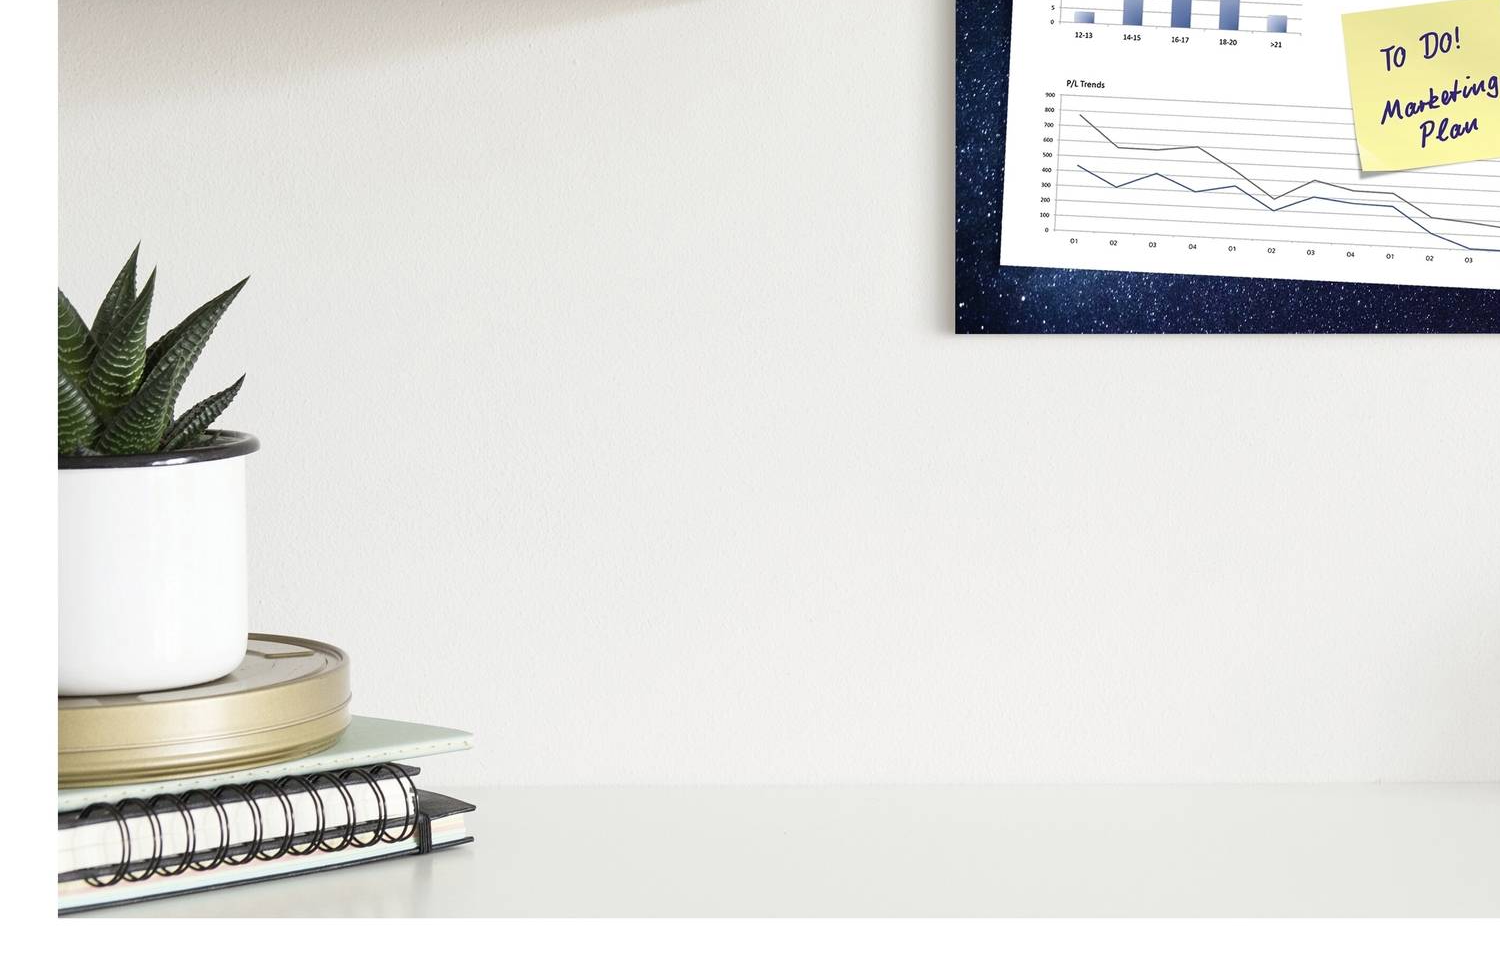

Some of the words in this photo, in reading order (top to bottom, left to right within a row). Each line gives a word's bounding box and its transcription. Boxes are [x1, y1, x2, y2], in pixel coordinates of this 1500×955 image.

[1122, 33, 1142, 42] 14-15
[1219, 38, 1238, 47] 18-20
[1380, 46, 1406, 71] TO
[1419, 26, 1460, 59] DO!
[1066, 80, 1078, 88] P/L
[1080, 80, 1106, 88] Trends
[1381, 75, 1498, 125] Marketing
[1420, 118, 1478, 148] Plan
